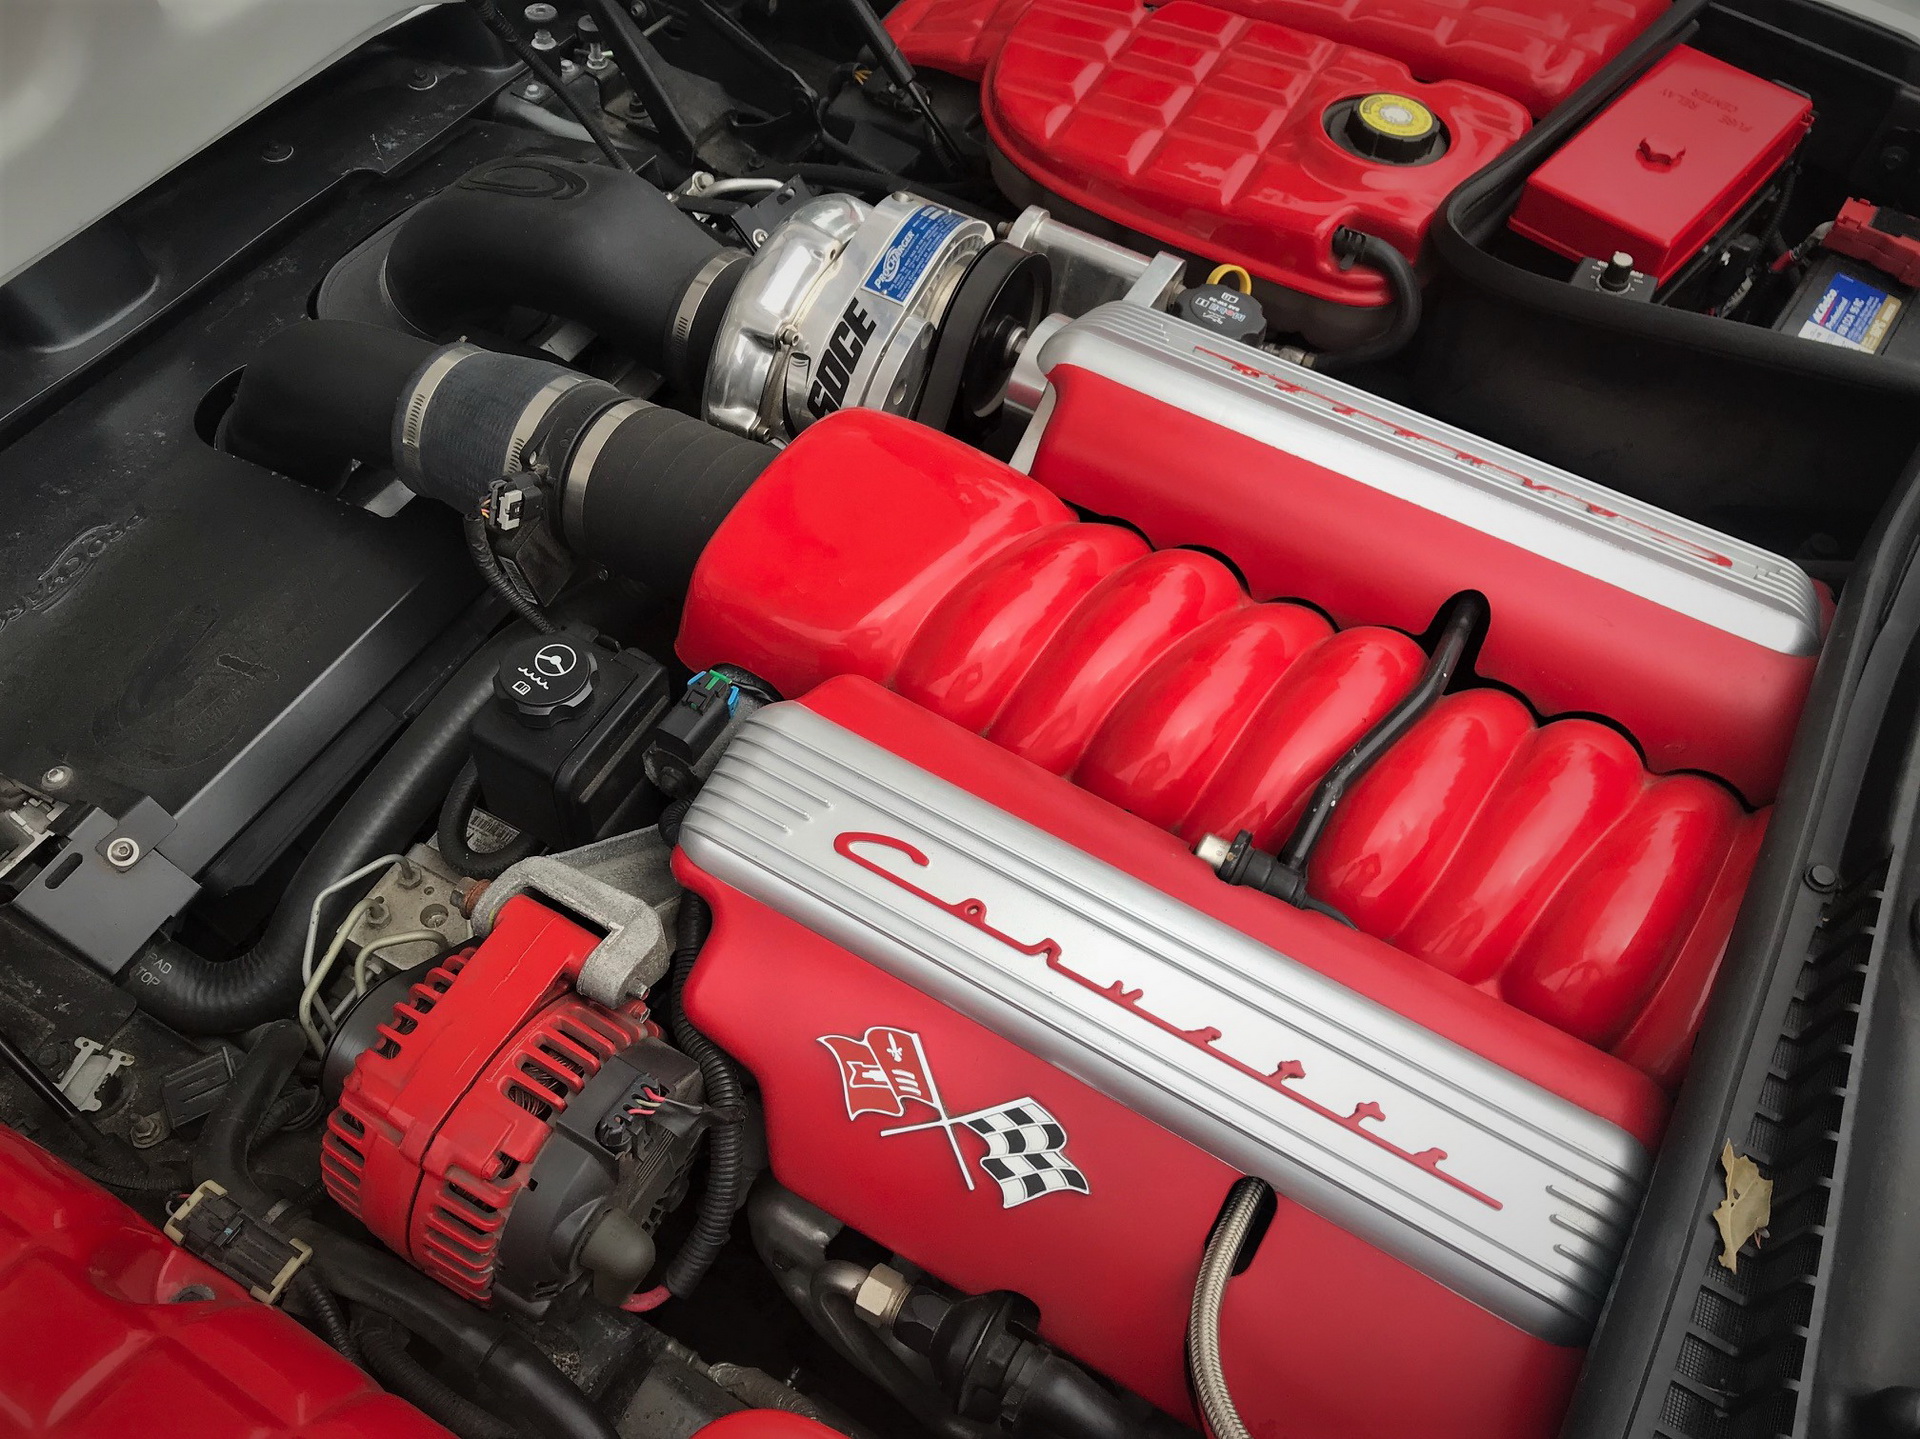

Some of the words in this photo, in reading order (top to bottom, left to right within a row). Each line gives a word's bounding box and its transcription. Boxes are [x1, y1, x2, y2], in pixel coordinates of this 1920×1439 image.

[1691, 88, 1739, 113] CENTER
[873, 229, 915, 290] PROCHARGER
[136, 965, 161, 986] TOP
[833, 831, 1504, 1211] Corvette
